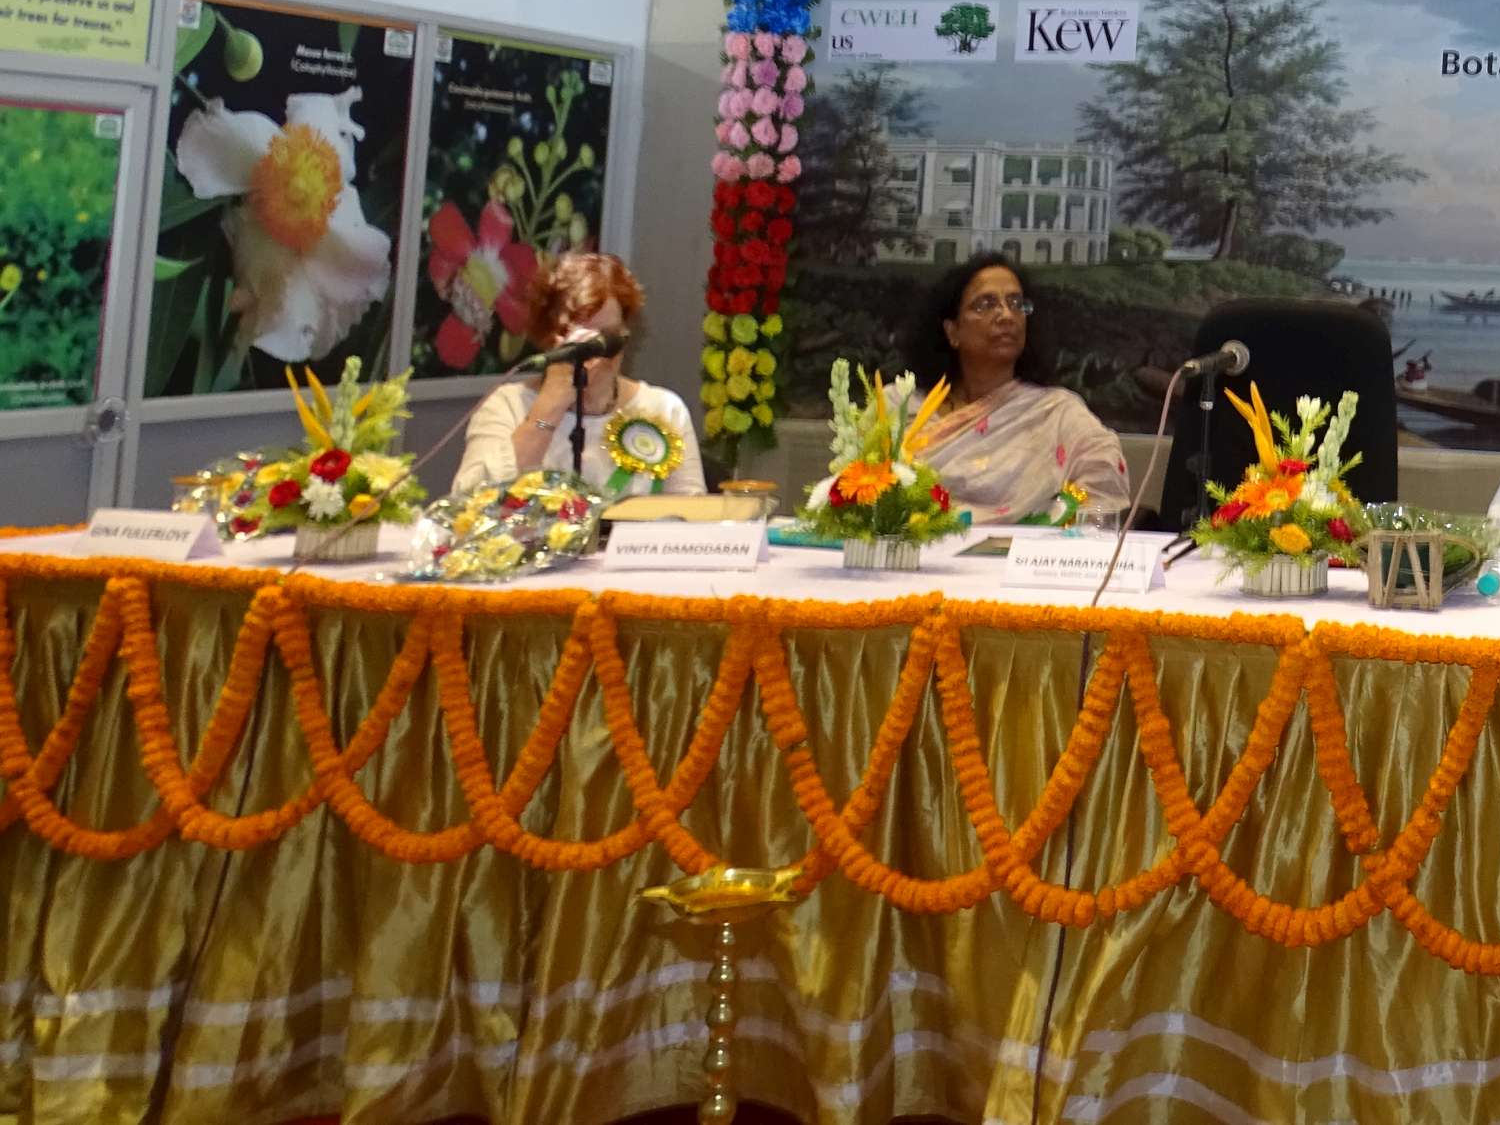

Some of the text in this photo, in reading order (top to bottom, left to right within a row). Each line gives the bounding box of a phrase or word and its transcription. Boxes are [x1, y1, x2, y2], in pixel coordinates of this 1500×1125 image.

[1025, 8, 1130, 53] Kew
[616, 543, 750, 556] VINITA DAMODARAN
